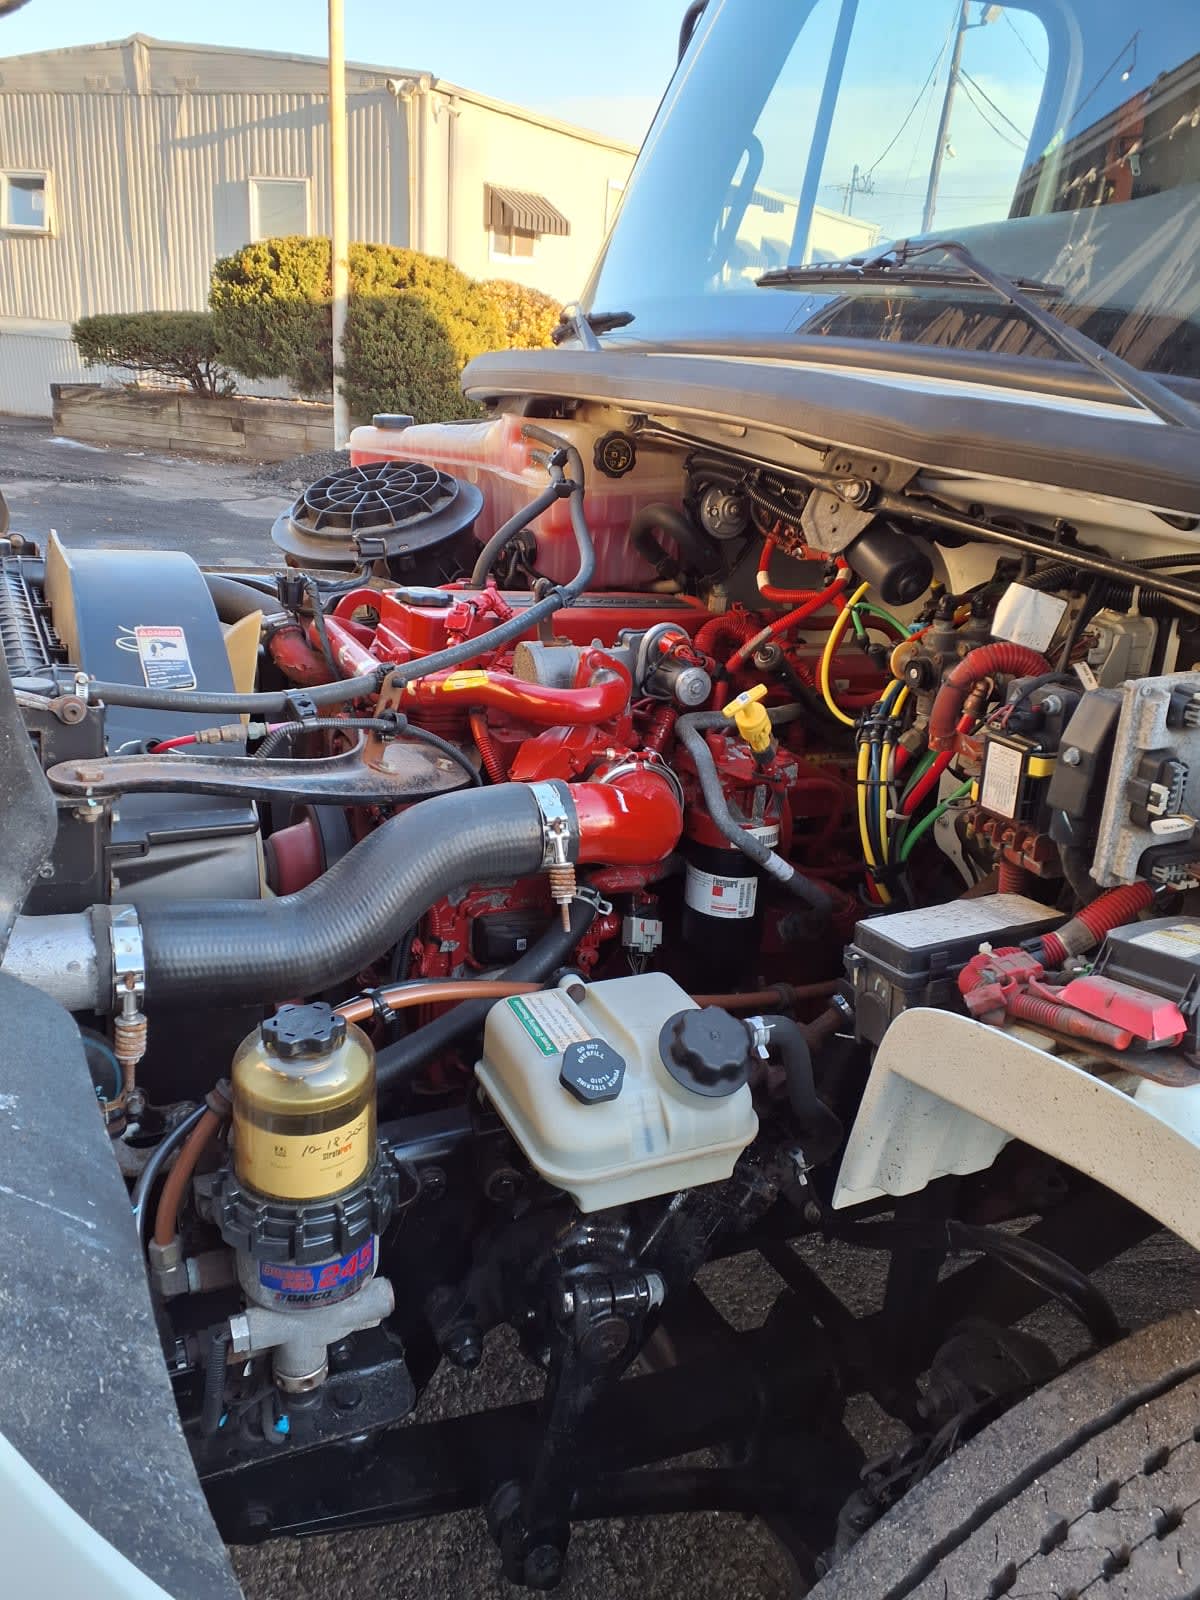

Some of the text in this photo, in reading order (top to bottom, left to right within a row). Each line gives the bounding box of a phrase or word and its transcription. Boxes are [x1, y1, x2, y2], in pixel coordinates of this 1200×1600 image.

[713, 877, 738, 888] Fleetguard
[578, 1050, 604, 1063] OVERFILL
[577, 1069, 620, 1091] POWER STEERING
[590, 1074, 610, 1084] FLUID
[318, 1240, 372, 1290] 245
[263, 1264, 315, 1290] DIESEL PRO
[286, 1290, 332, 1302] DAVCO
